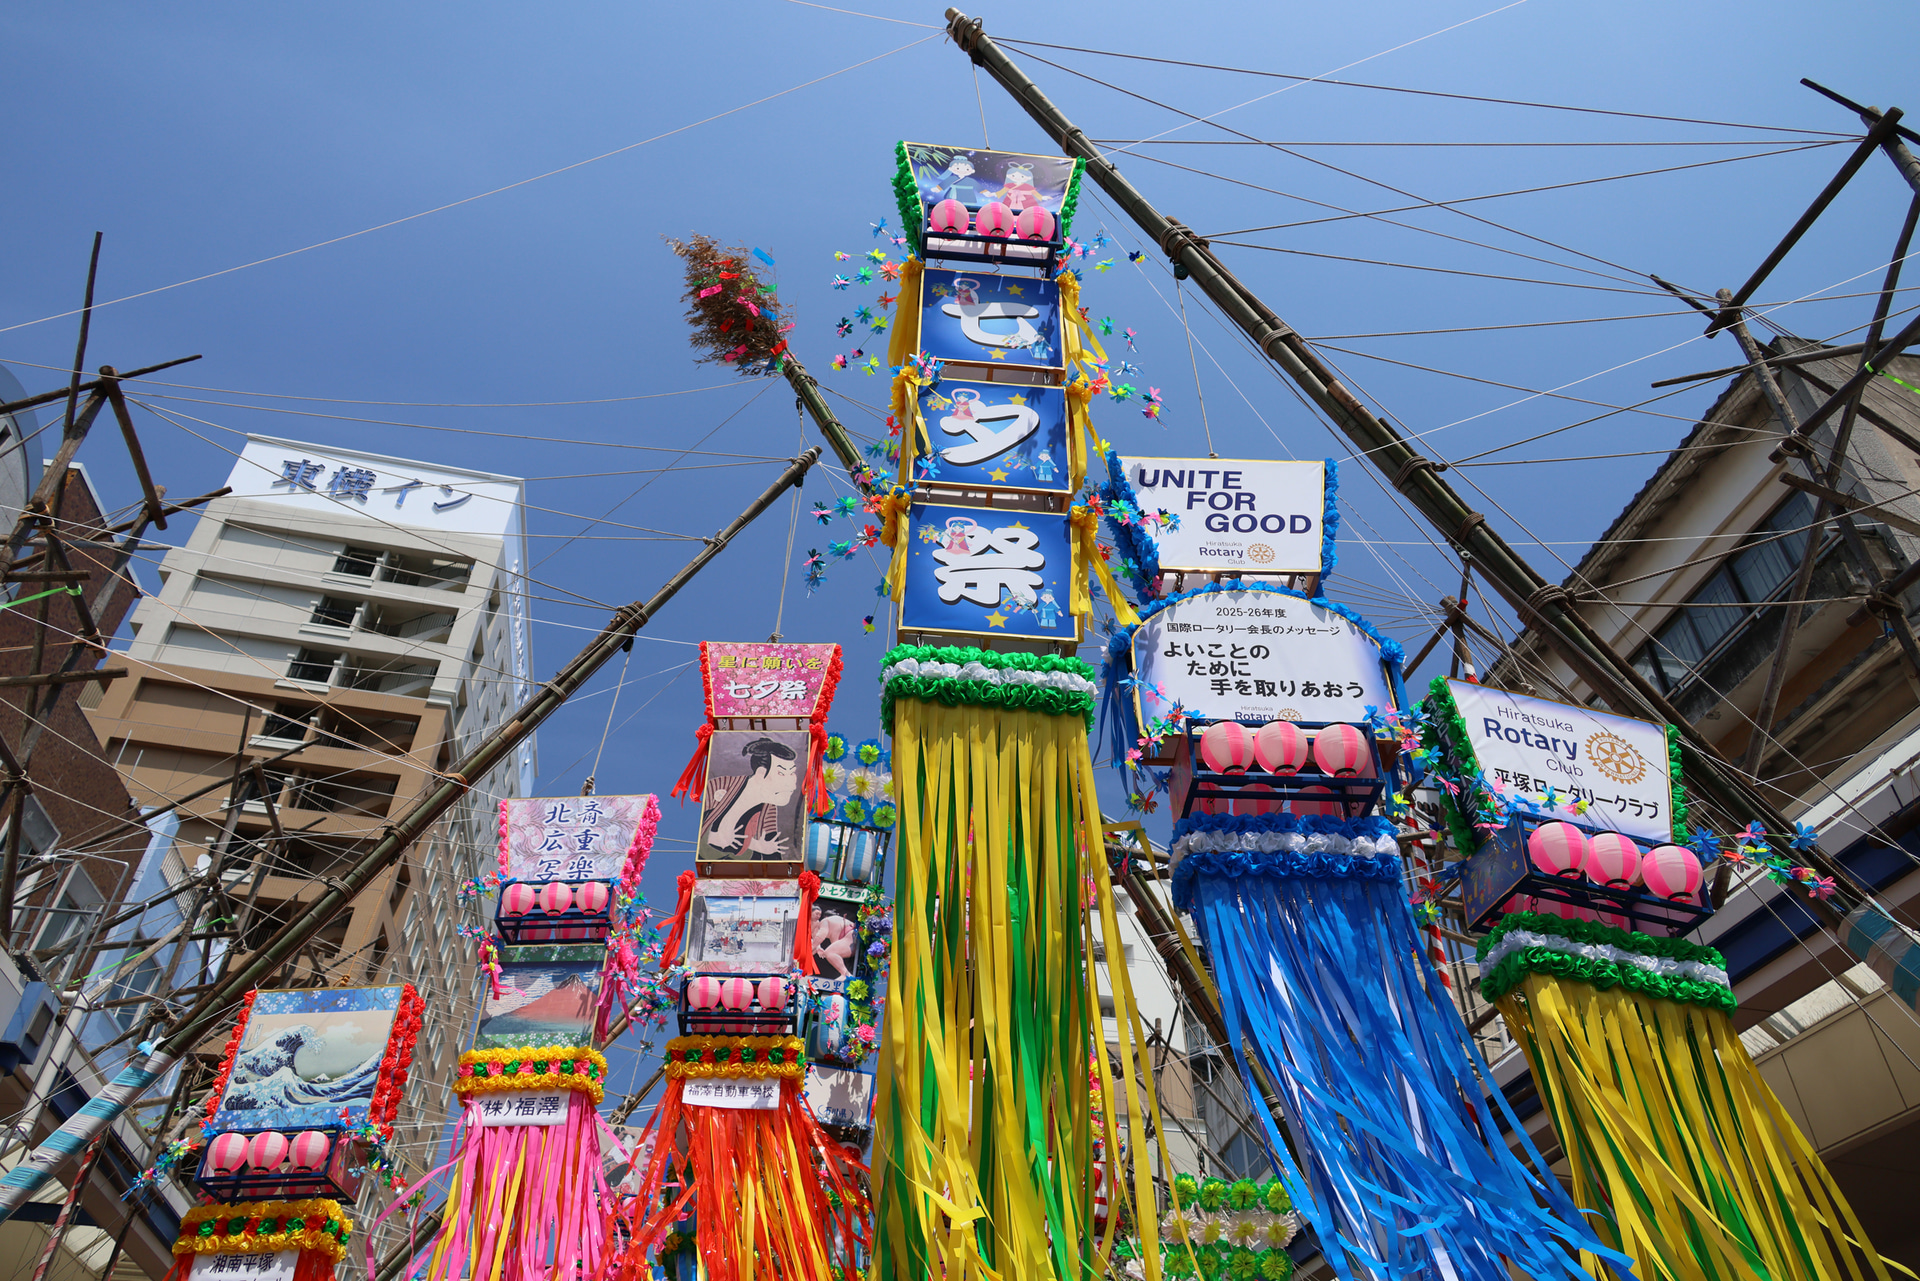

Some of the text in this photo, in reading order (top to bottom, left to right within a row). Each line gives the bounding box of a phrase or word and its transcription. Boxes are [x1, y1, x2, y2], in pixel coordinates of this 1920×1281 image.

[272, 459, 473, 513] 東横イン
[1138, 469, 1243, 489] UNITE
[1187, 491, 1256, 511] FOR
[1205, 513, 1312, 534] GOOD
[1199, 547, 1244, 558] Rotary
[1216, 607, 1287, 618] 2025-26年度
[1167, 622, 1341, 636] 国際ロータリー会長のメッセージ
[1164, 641, 1270, 660] よいことの
[718, 656, 822, 670] 星に願いを
[1187, 660, 1252, 677] ために
[724, 680, 807, 700] 七夕祭
[1210, 678, 1365, 698] 手を取りあおう
[1497, 705, 1574, 733] Hiratsuka
[1483, 717, 1578, 761] Rotary
[1546, 758, 1584, 777] Club
[1494, 767, 1660, 819] 平塚ロータリークラブ
[538, 829, 600, 851] 広重
[536, 856, 595, 880] 写楽
[209, 1252, 275, 1274] 湘南平塚
